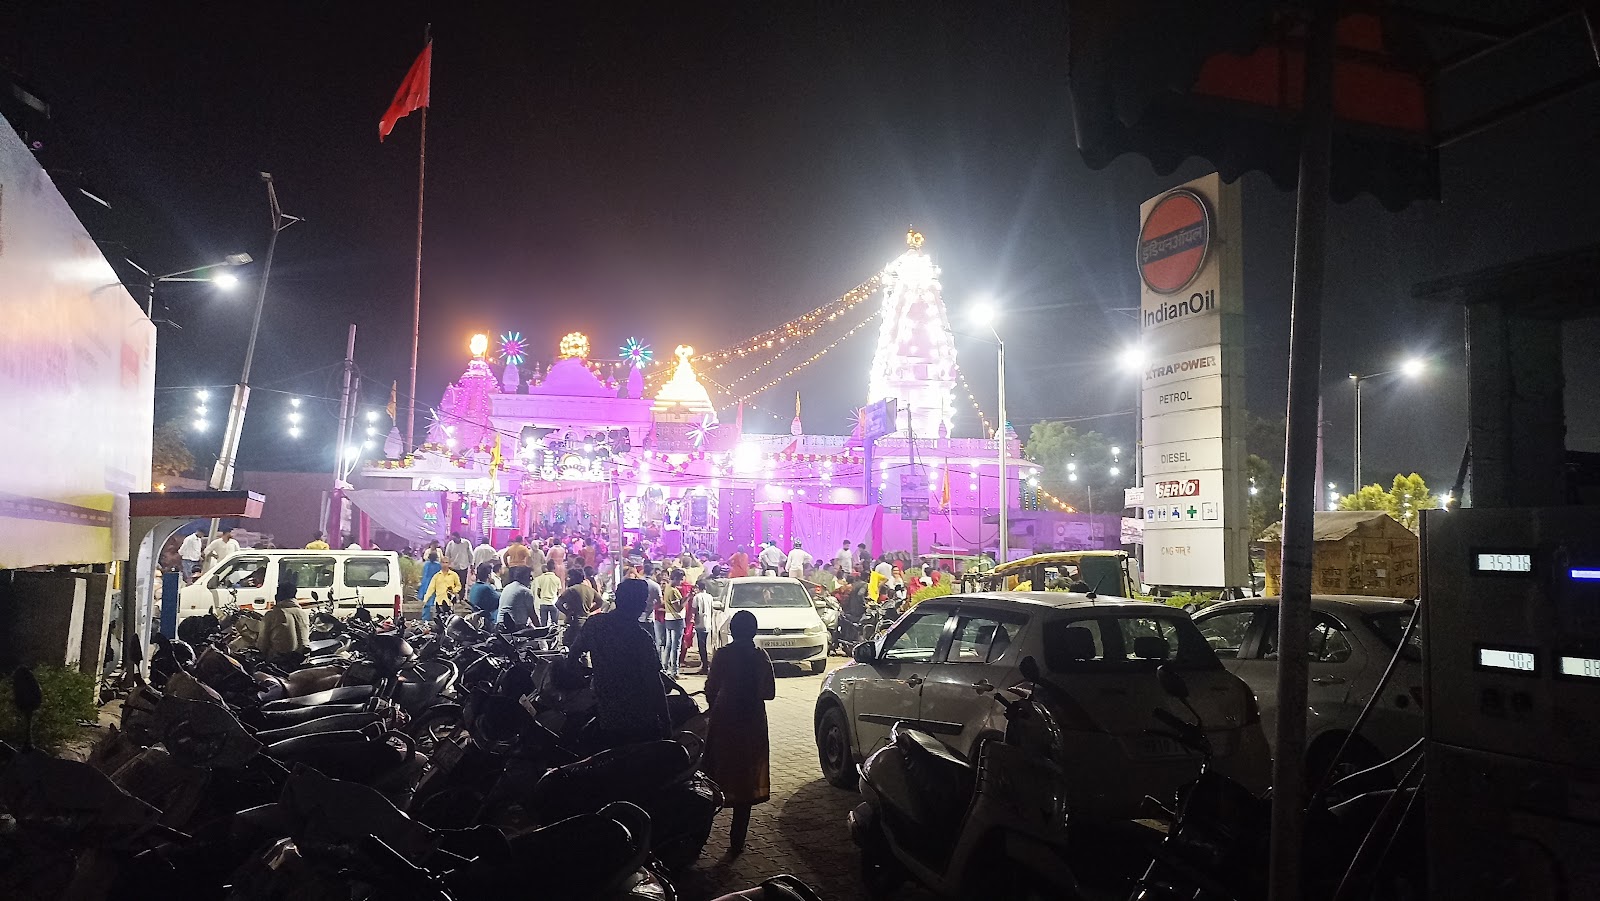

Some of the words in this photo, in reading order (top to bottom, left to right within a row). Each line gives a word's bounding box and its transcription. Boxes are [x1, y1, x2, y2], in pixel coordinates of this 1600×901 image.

[1144, 290, 1215, 328] IndianOil
[1145, 356, 1217, 380] XTRAPOWER
[1160, 391, 1193, 404] PETROL
[1161, 452, 1191, 464] DIESEL
[1155, 481, 1196, 498] SERVO
[1161, 546, 1174, 556] CNG
[1508, 653, 1533, 670] 402
